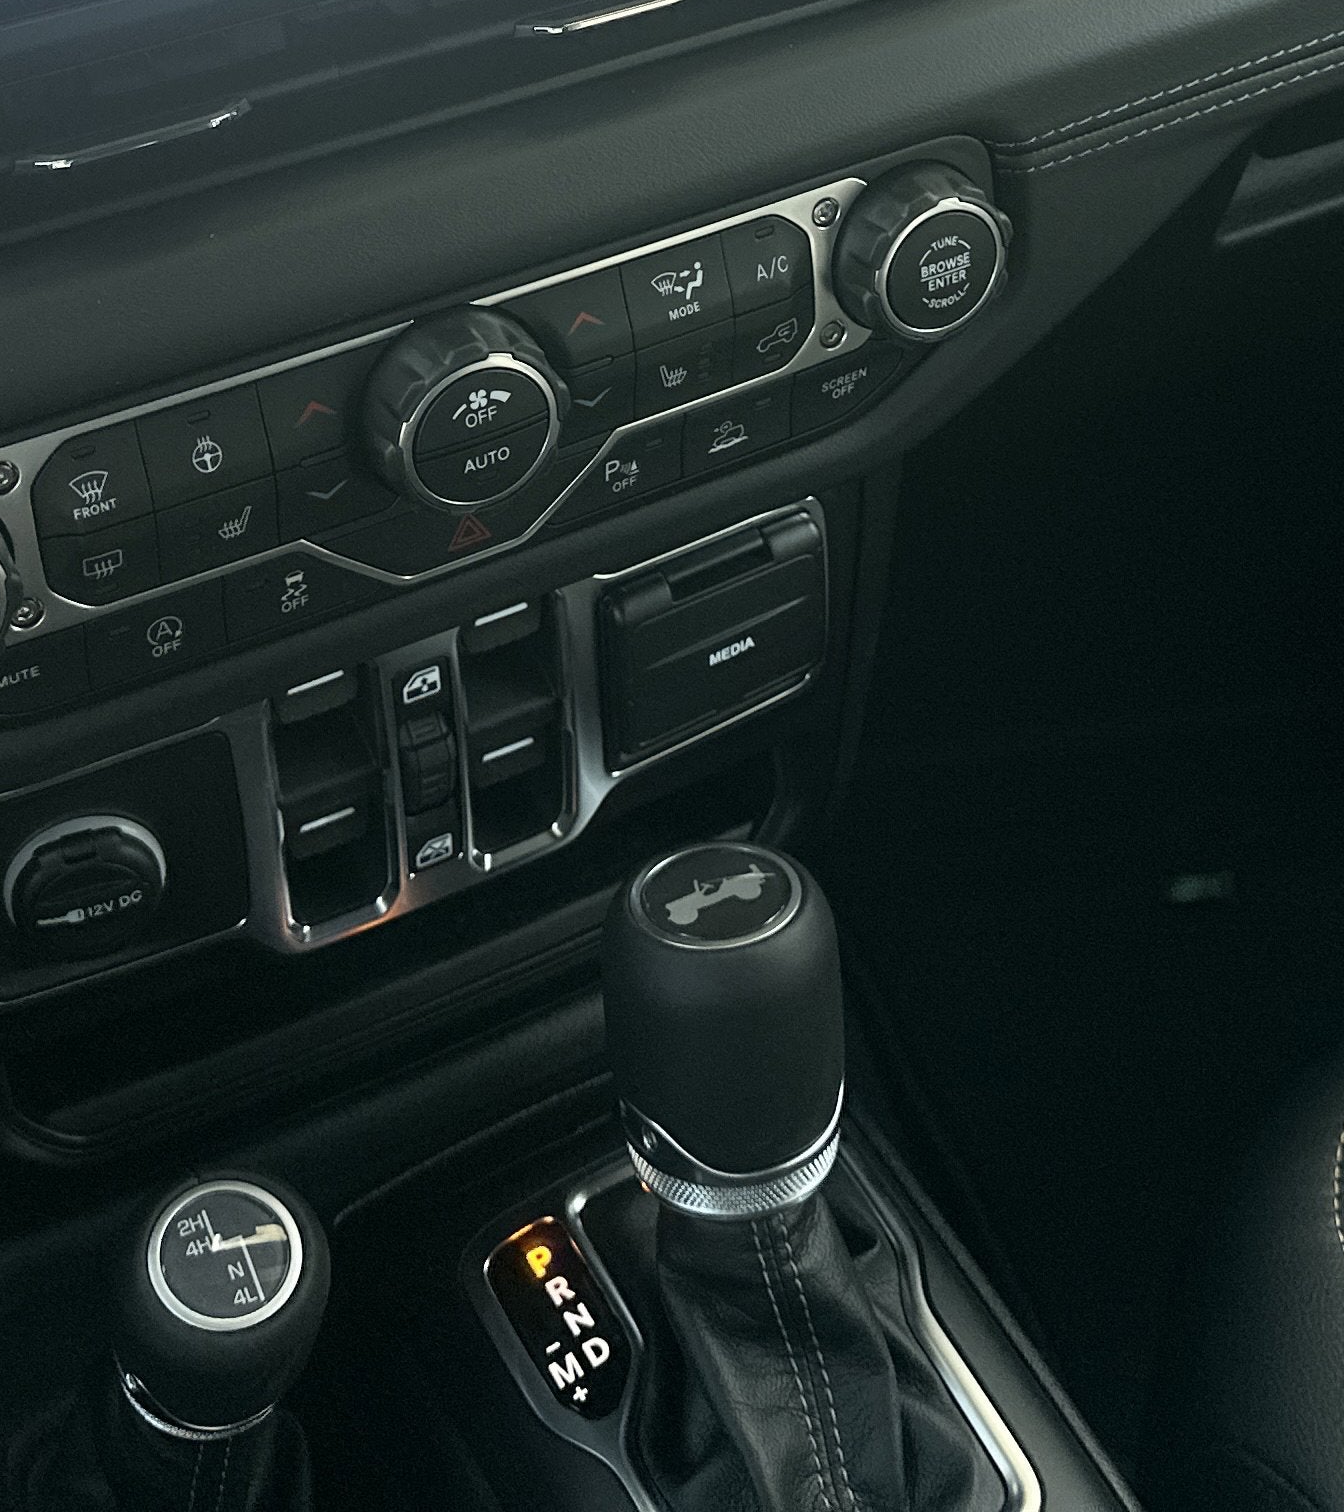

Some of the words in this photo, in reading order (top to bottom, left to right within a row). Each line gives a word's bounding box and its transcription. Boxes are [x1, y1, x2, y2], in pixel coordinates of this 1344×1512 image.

[930, 235, 959, 251] TUNE
[756, 254, 789, 283] A/C
[920, 251, 970, 278] BROWSE
[928, 269, 967, 292] ENTER
[668, 301, 702, 322] MODE
[927, 289, 967, 309] SCROLL
[820, 366, 868, 396] SCREEN
[831, 382, 858, 400] OFF
[464, 404, 498, 429] OFF
[463, 445, 511, 474] AUTO
[611, 473, 639, 493] OFF
[72, 497, 117, 520] FRONT
[280, 594, 310, 615] OFF
[151, 638, 183, 658] OFF
[708, 636, 757, 667] MEDIA
[84, 895, 116, 919] 12V
[118, 890, 144, 910] DC
[176, 1214, 204, 1239] 2H
[184, 1237, 209, 1258] 4H
[227, 1261, 245, 1280] N
[525, 1245, 553, 1279] P
[232, 1286, 258, 1306] 4L
[544, 1275, 576, 1307] R
[562, 1305, 596, 1337] N
[581, 1336, 612, 1369] D
[547, 1352, 585, 1390] M
